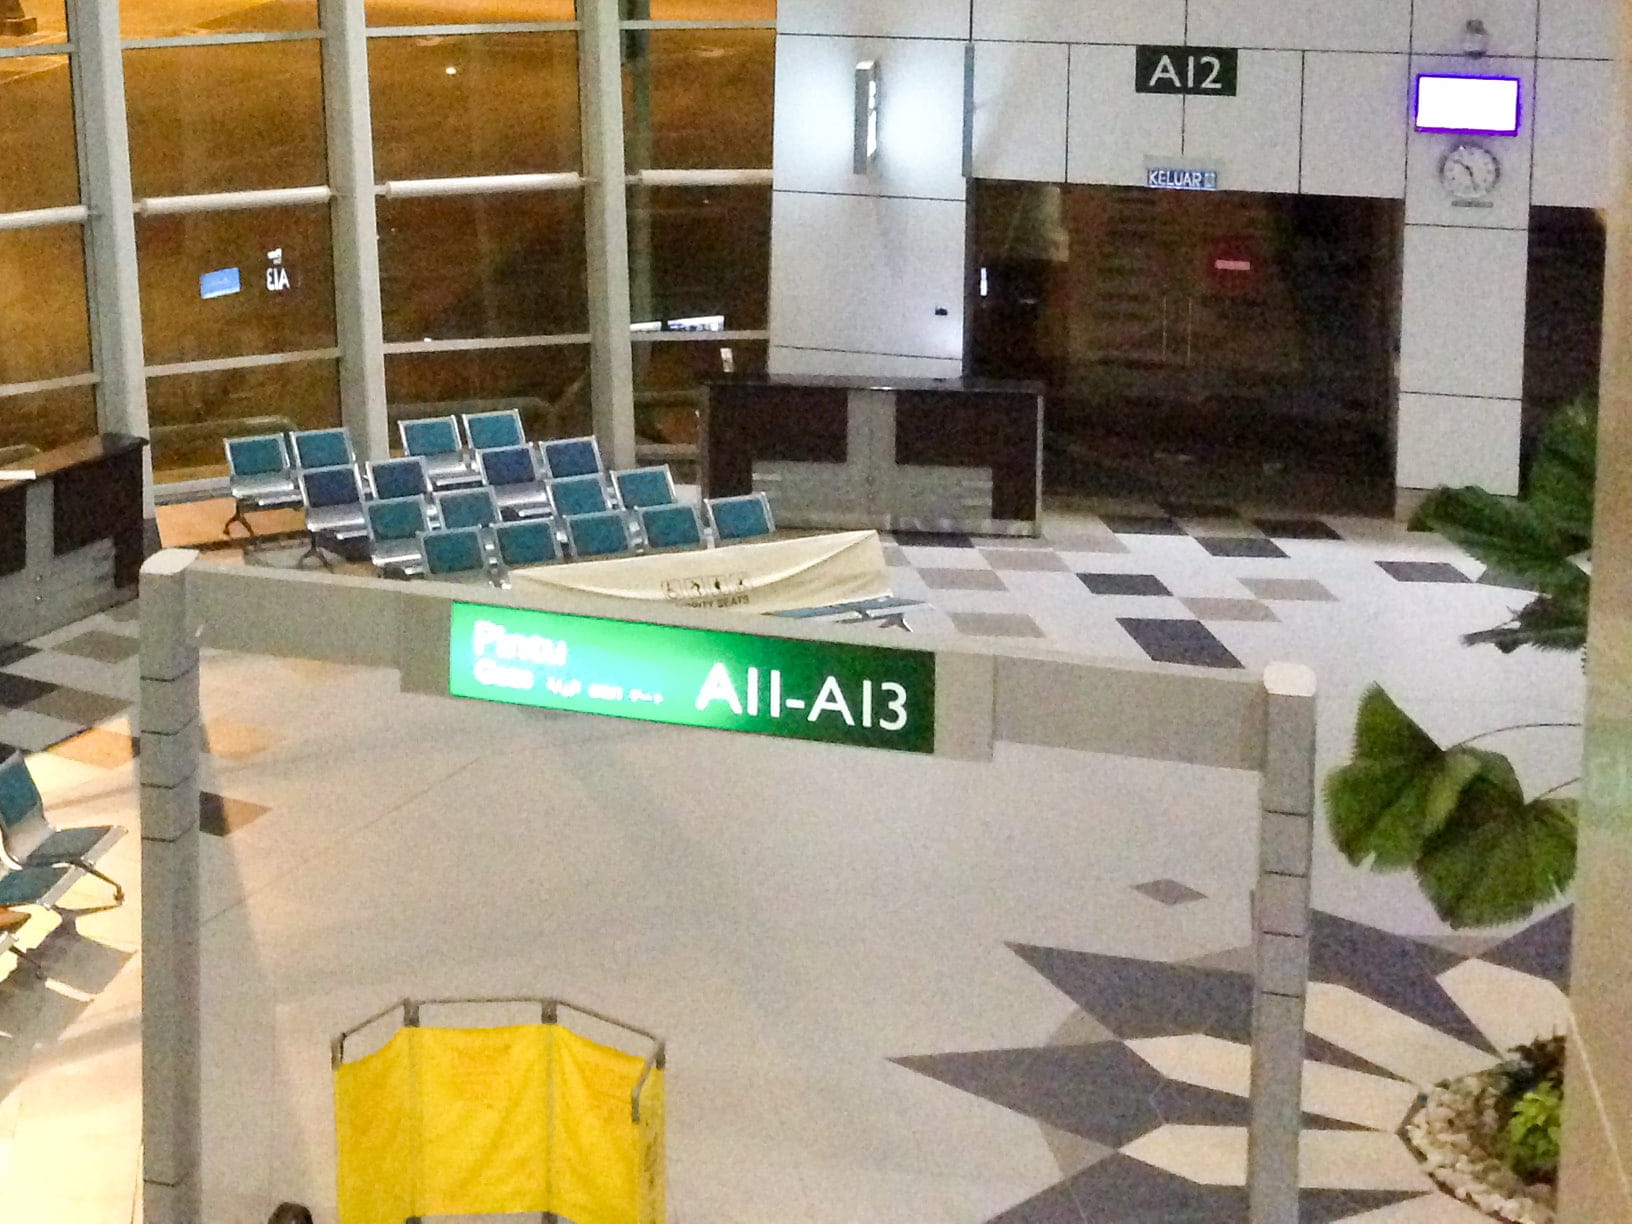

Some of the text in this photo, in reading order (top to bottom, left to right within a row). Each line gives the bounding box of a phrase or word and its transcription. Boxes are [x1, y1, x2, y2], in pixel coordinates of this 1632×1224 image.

[1148, 54, 1223, 89] A12
[1148, 170, 1203, 187] KELUAR
[694, 662, 908, 731] A11-A13
